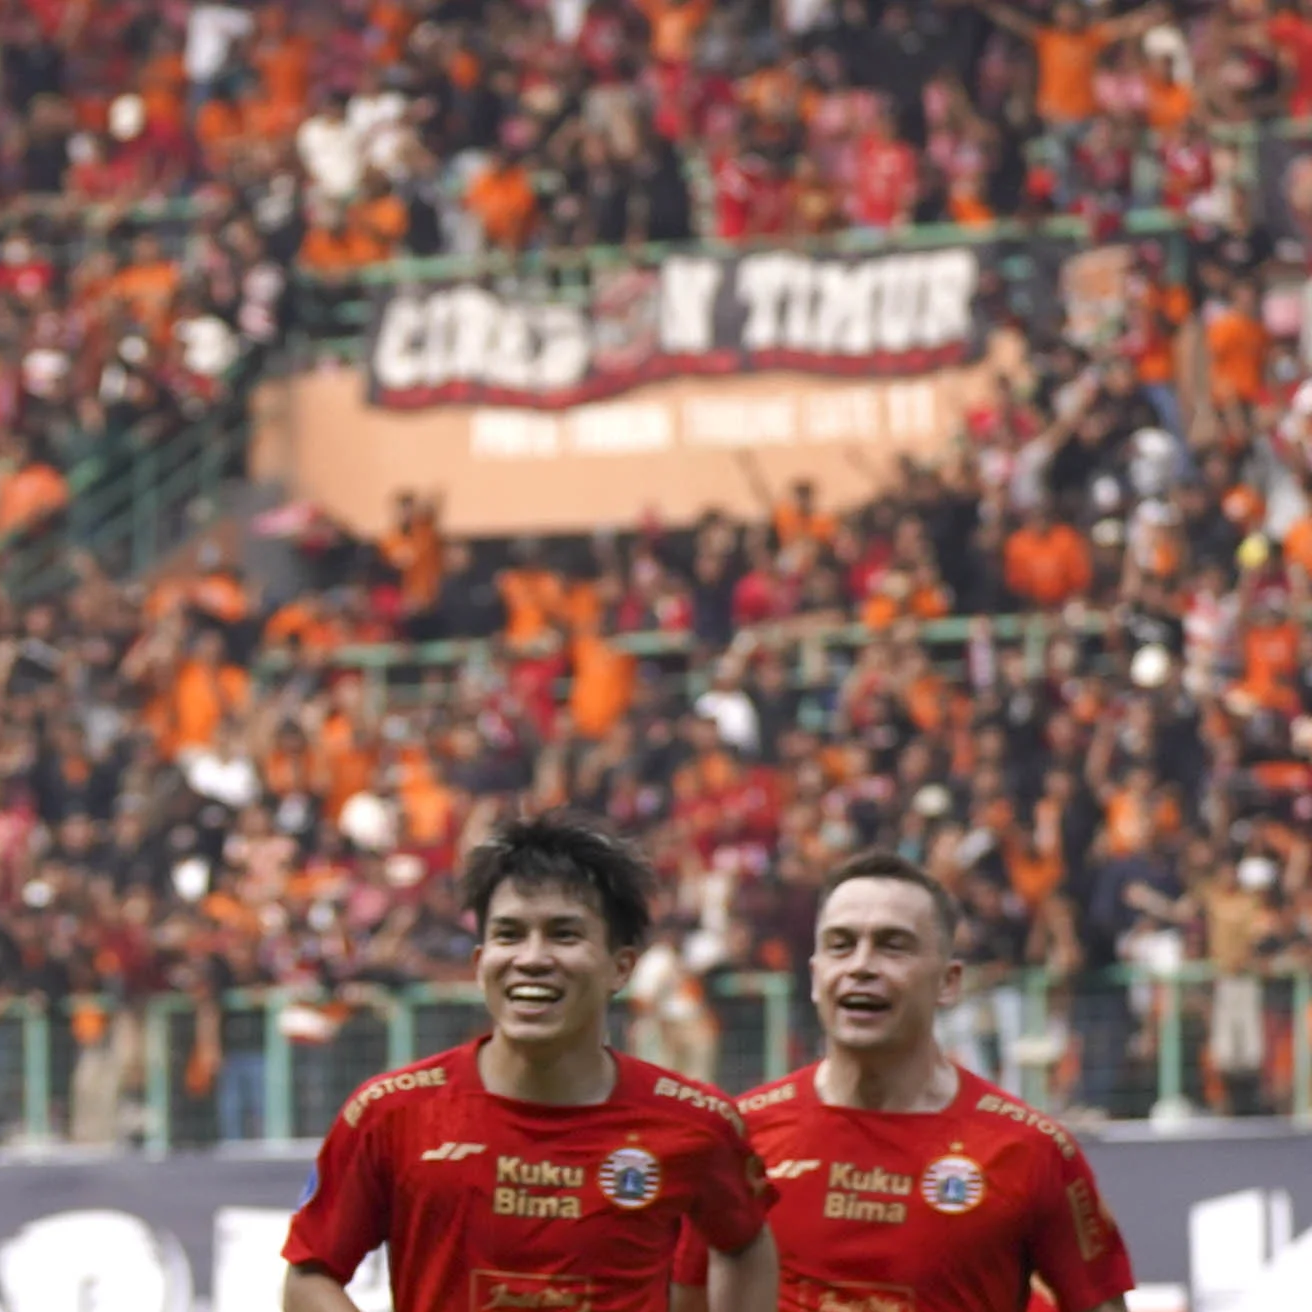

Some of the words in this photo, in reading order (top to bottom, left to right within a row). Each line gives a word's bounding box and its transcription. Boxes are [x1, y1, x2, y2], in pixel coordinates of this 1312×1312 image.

[497, 1156, 584, 1188] Kuku
[829, 1162, 913, 1195] Kuku
[493, 1187, 581, 1219] Bima
[823, 1191, 907, 1224] Bima
